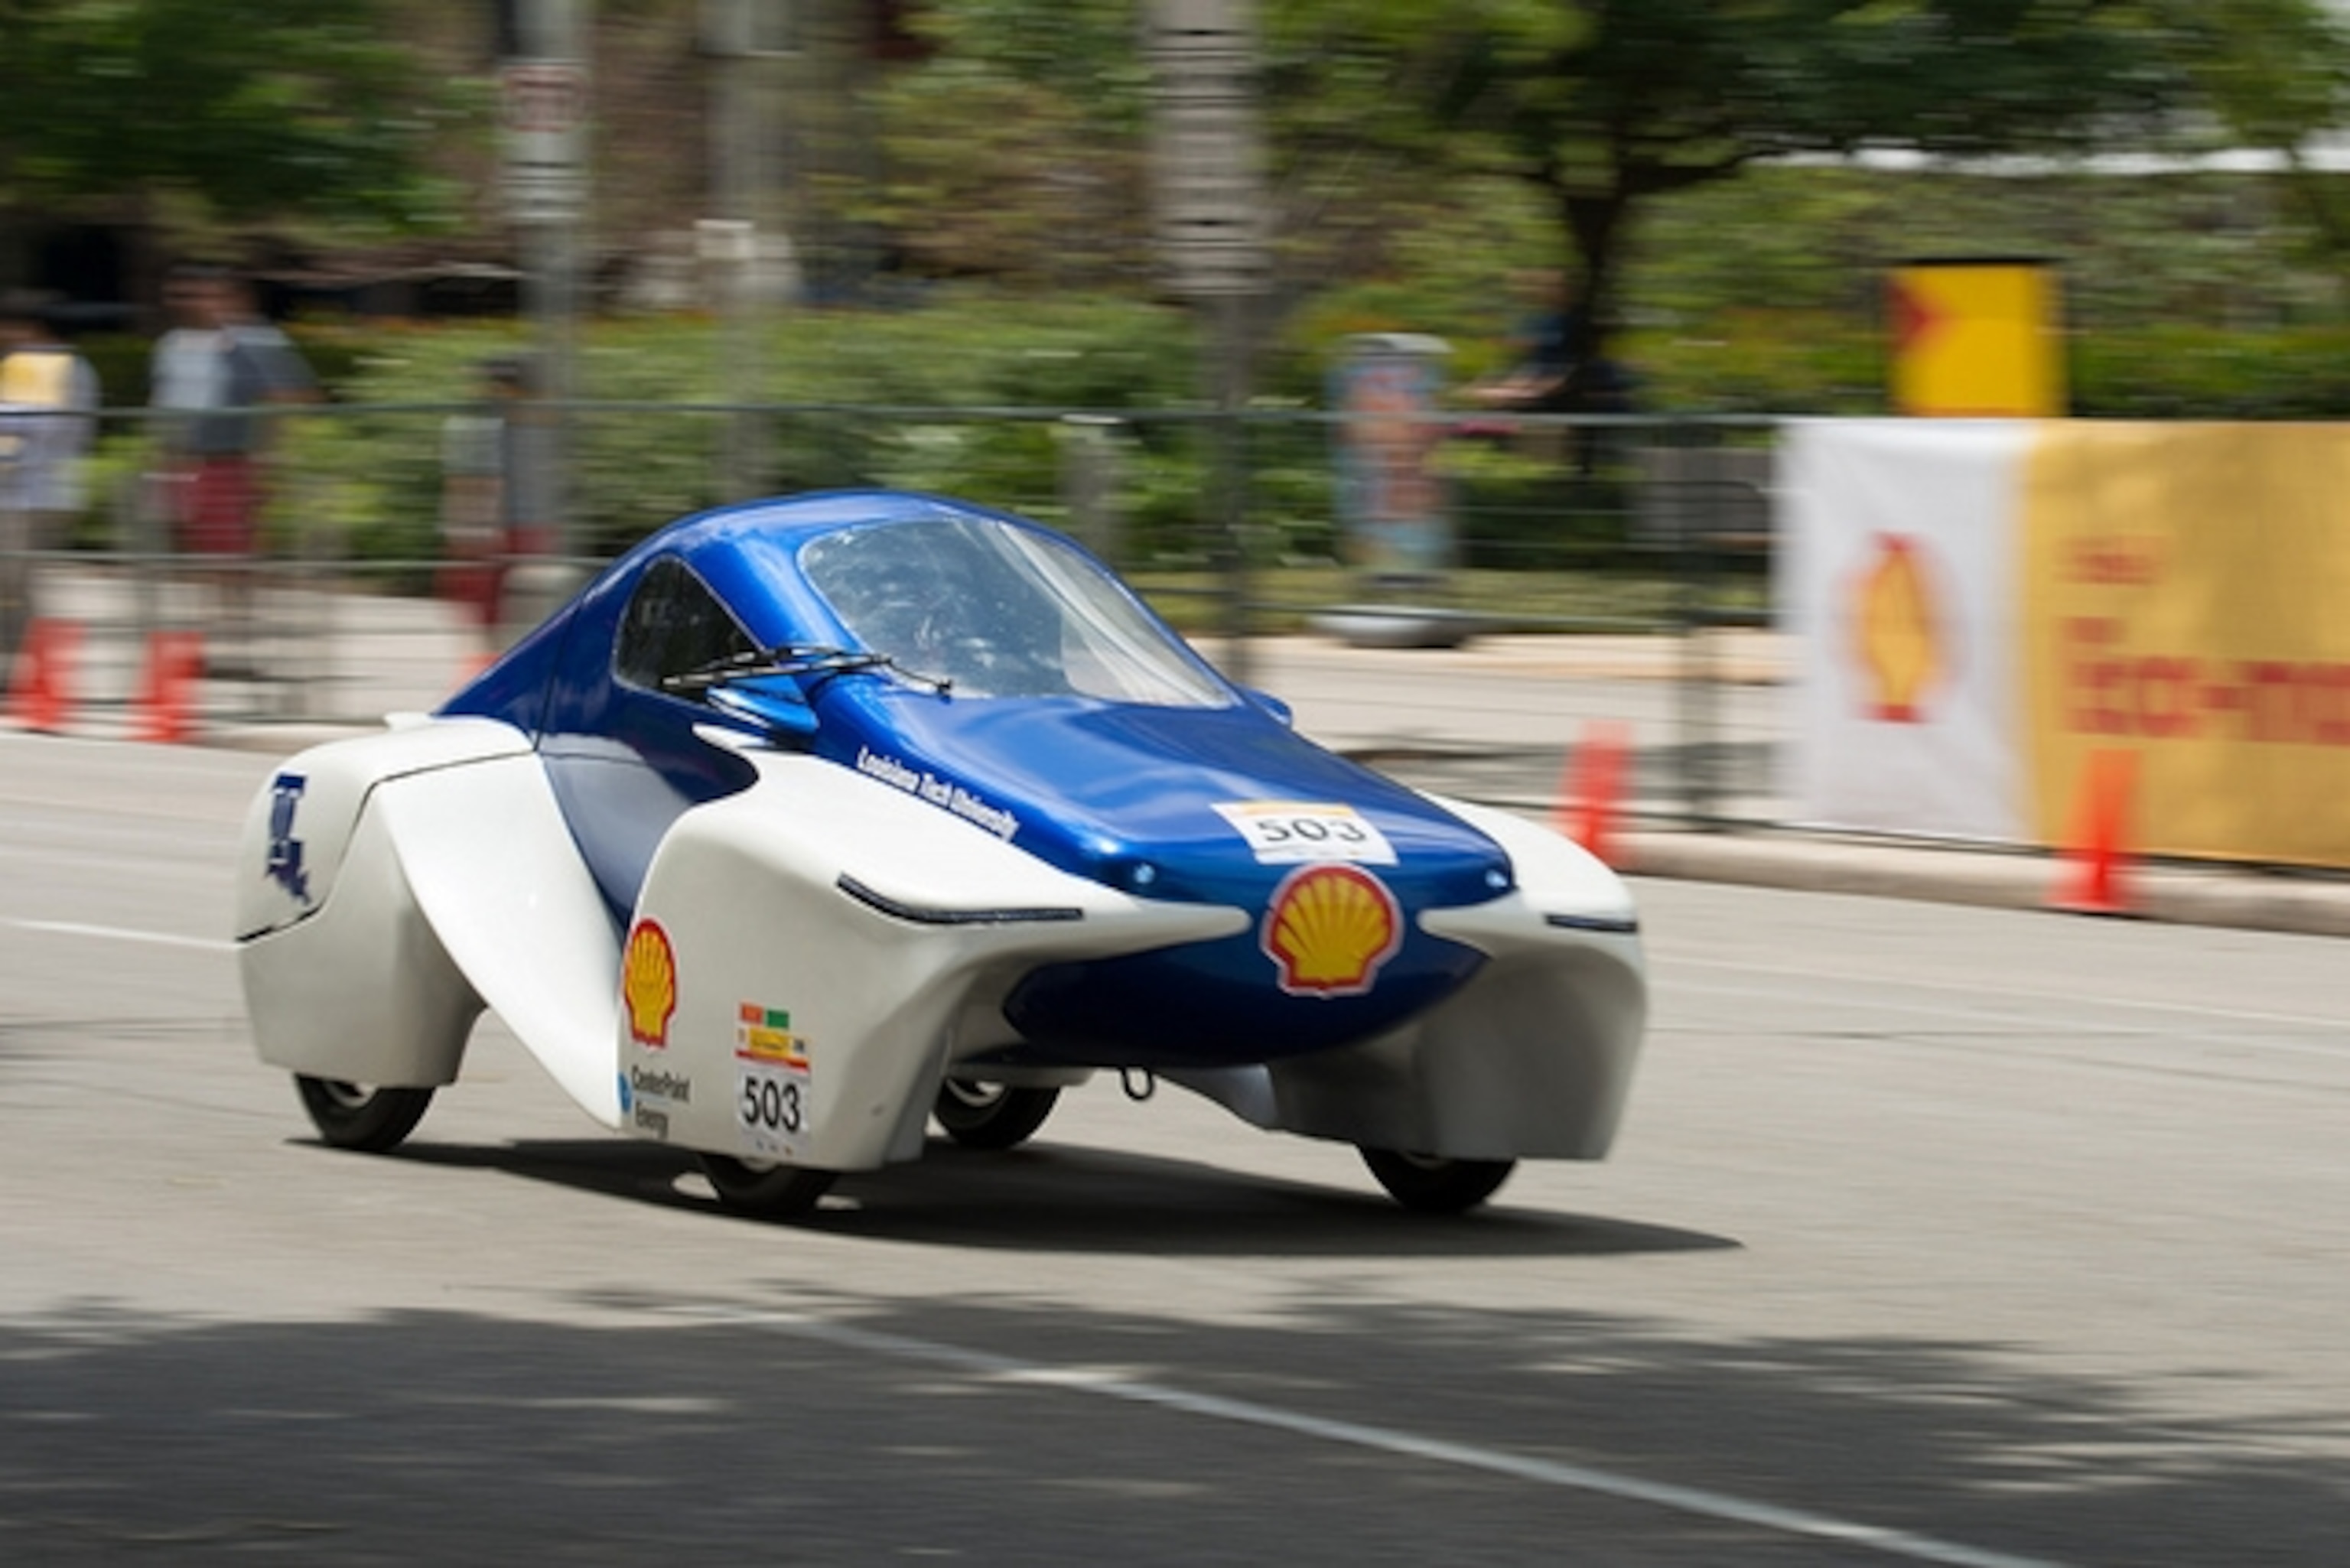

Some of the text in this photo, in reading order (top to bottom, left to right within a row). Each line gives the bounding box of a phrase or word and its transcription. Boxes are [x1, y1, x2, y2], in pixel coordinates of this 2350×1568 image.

[857, 744, 1020, 842] Louisiana Tech University
[1257, 818, 1367, 842] 503
[632, 1064, 691, 1104] CenterPoint
[742, 1075, 801, 1134] 503
[635, 1099, 669, 1142] Energy
